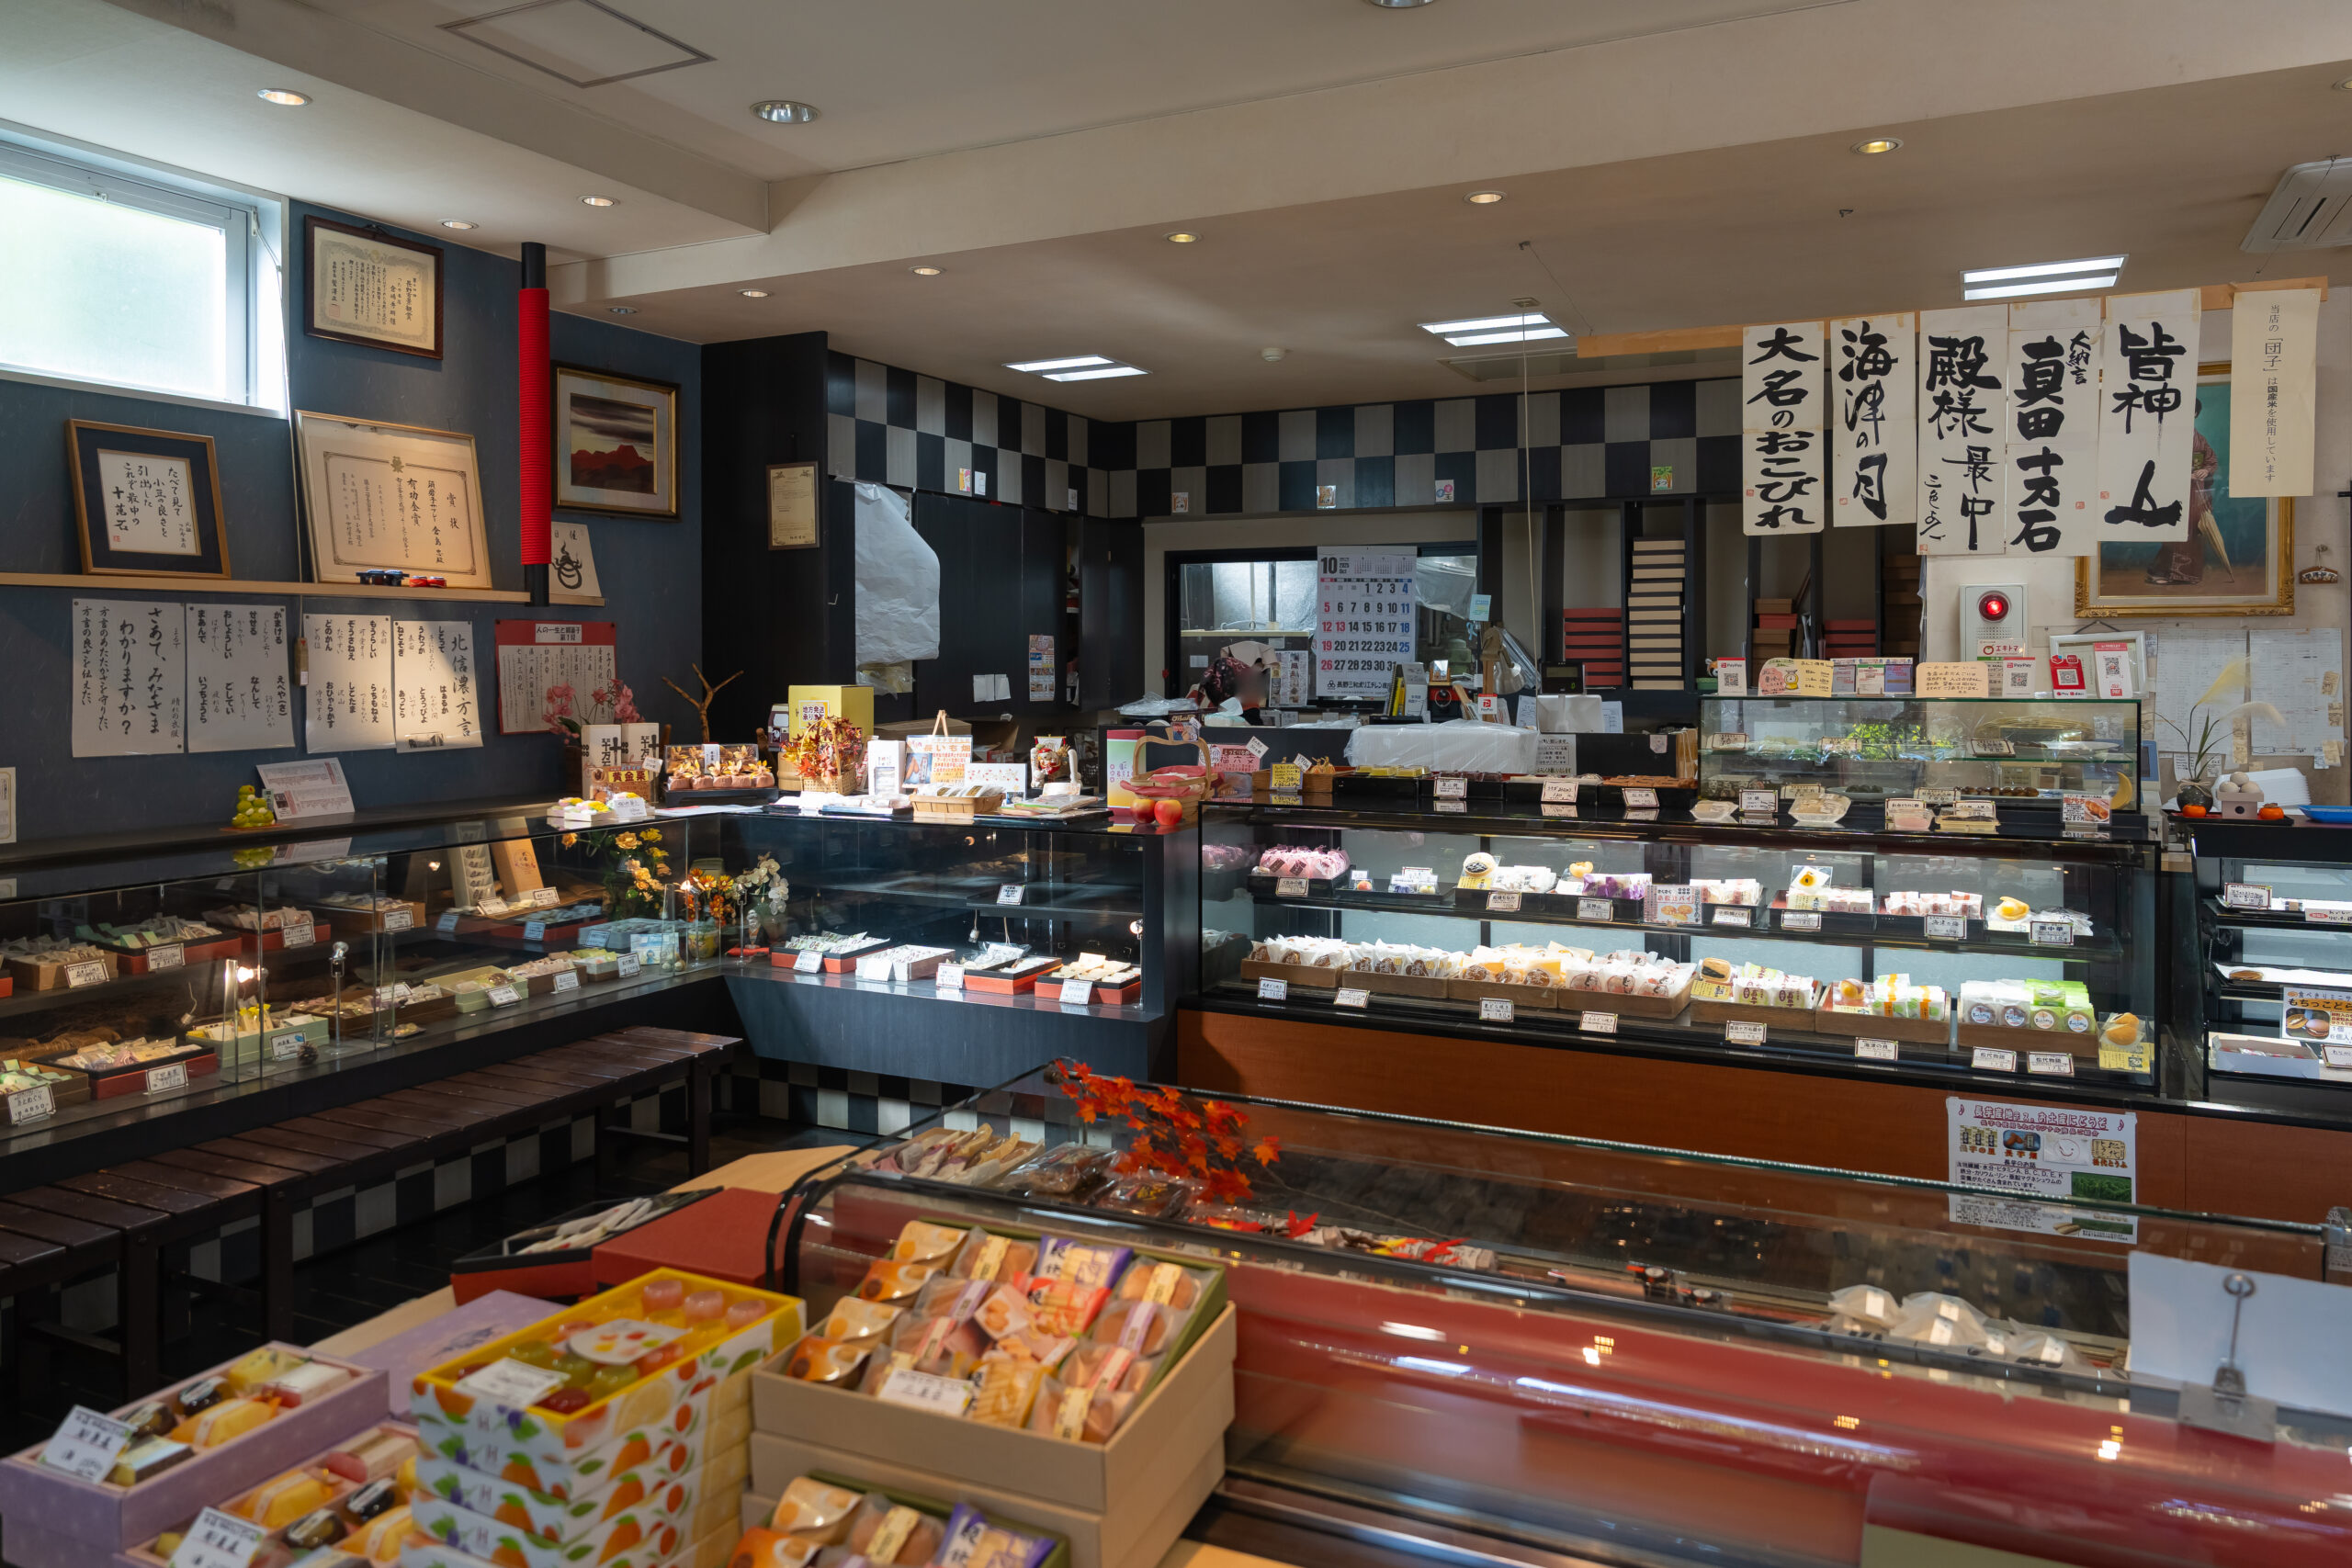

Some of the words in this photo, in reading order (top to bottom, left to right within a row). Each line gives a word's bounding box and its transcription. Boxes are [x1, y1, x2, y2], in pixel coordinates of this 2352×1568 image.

[2067, 330, 2091, 385] 大納言
[2263, 304, 2284, 483] 当店の「団子」は国産米を使用しています
[1747, 327, 1820, 529] 大名のおこびれ
[1838, 320, 1898, 520] 海津の月
[1926, 336, 2002, 550] 殿様最中
[2104, 322, 2186, 528] 皆神山
[2010, 335, 2065, 552] 真田十万石
[123, 462, 140, 525] これぞ最中の
[137, 465, 153, 508] 引出した
[153, 478, 168, 537] 小豆の良さを
[168, 467, 183, 516] たべて見て
[1321, 557, 1338, 574] 10
[1365, 583, 1370, 593] 1
[1376, 583, 1382, 593] 2
[1389, 583, 1395, 593] 3
[1402, 583, 1408, 593] 4
[198, 610, 207, 644] まあんで
[249, 610, 257, 636] せせる
[274, 611, 282, 644] かまける
[1322, 622, 1332, 632] 12
[1336, 622, 1345, 632] 13
[1349, 622, 1359, 632] 14
[1362, 622, 1372, 632] 15
[1375, 622, 1385, 632] 16
[1387, 622, 1397, 632] 17
[1400, 623, 1409, 633] 18
[1324, 603, 1330, 613] 5
[1338, 603, 1343, 613] 6
[1351, 603, 1356, 613] 7
[1364, 603, 1370, 613] 8
[1376, 603, 1383, 613] 9
[1387, 603, 1397, 613] 10
[1401, 604, 1409, 614] 11
[81, 606, 92, 705] 方言の良さを伝えたい
[223, 610, 232, 660] おしょうしい
[324, 619, 333, 651] どのかん
[347, 620, 356, 660] ぞうさねえ
[1322, 641, 1332, 651] 19
[1334, 641, 1346, 651] 20
[1349, 641, 1359, 651] 21
[1362, 641, 1372, 651] 22
[1374, 641, 1385, 651] 23
[1386, 641, 1397, 651] 24
[1399, 642, 1409, 652] 25
[99, 606, 109, 731] 方言のあたたかさを守りたい
[119, 619, 136, 735] わかりますか？
[147, 607, 166, 734] さあて、みなさま
[451, 634, 471, 737] 北信濃方言
[1321, 660, 1332, 671] 26
[1334, 660, 1345, 671] 27
[1348, 660, 1359, 671] 28
[1362, 660, 1372, 671] 29
[1374, 660, 1385, 671] 30
[198, 676, 207, 724] いっちょうら
[251, 676, 261, 709] なんして
[326, 682, 334, 728] おひゃらかす
[348, 682, 356, 714] しこたま
[370, 683, 379, 723] らちもねえ
[2004, 1159, 2036, 1168] 長芋のお話
[2005, 1149, 2038, 1159] 長芋畑
